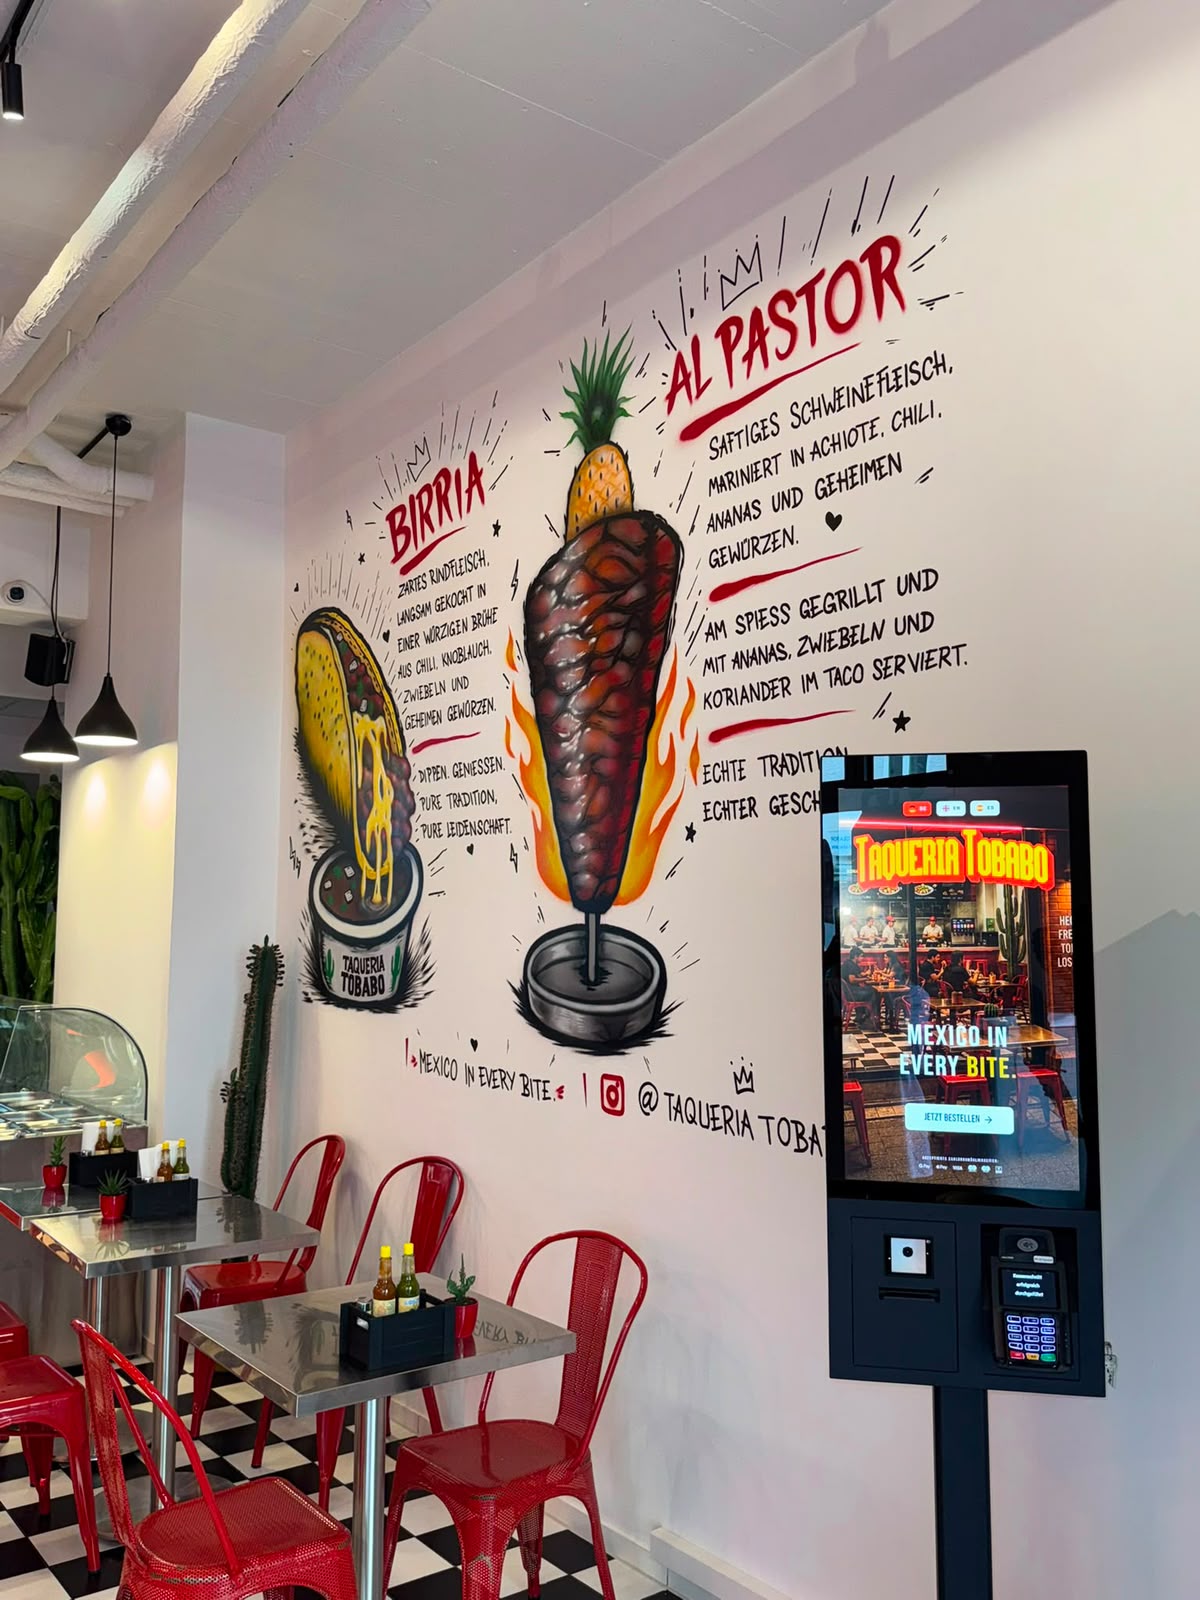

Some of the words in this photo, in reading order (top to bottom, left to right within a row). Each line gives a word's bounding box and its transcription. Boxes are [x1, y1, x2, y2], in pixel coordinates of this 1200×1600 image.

[665, 334, 712, 416] AL
[715, 234, 906, 389] PASTOR
[709, 412, 780, 460] SAFTIGES
[790, 350, 953, 429] SCHWEINEFLEISCH,
[708, 453, 782, 497] MARINIERT
[790, 447, 805, 468] IN
[706, 499, 762, 534] ANANAS
[771, 487, 803, 513] UND
[814, 451, 902, 501] GEHEIMEN
[385, 451, 485, 564] BIRRIA
[708, 525, 799, 569] GEWÜRZEN.
[397, 573, 428, 599] ZARTES
[397, 601, 432, 626] LANGSAM
[434, 585, 474, 612] GEKOCHT
[477, 582, 487, 599] IN
[704, 619, 727, 643] AM
[735, 603, 791, 635] SPIESS
[800, 579, 886, 620] GEGRILLT
[897, 568, 939, 596] UND
[397, 632, 420, 653] EINER
[423, 617, 468, 645] WÜRZIGEN
[471, 606, 499, 631] BRÜHE
[702, 654, 727, 677] MIT
[731, 642, 792, 670] ANANAS,
[797, 619, 886, 657] ZWIEBELN
[894, 611, 935, 636] UND
[397, 662, 412, 679] AUS
[702, 676, 791, 710] KORIANDER
[801, 673, 819, 694] IM
[823, 663, 864, 688] TACO
[872, 644, 968, 681] SERVIERT.
[403, 680, 446, 704] ZWIEBELN
[451, 675, 470, 692] UND
[404, 709, 442, 731] GEHEIMEN
[418, 765, 450, 783] DIPPEN.
[452, 756, 505, 779] GENIESSEN.
[703, 759, 746, 785] ECHTE
[419, 794, 442, 811] PURE
[446, 789, 498, 809] TRADITION,
[703, 796, 758, 822] ECHTER
[421, 822, 443, 839] PURE
[446, 818, 512, 838] LEIDENSCHAFT.
[342, 954, 385, 975] TAQUERIA
[341, 971, 385, 997] TOBABO
[907, 1023, 980, 1047] MEXICO
[987, 1026, 1008, 1048] IN
[418, 1049, 458, 1081] MEXICO
[464, 1063, 475, 1088] IN
[478, 1066, 516, 1091] EVERY
[519, 1073, 557, 1102] BITE.
[900, 1053, 959, 1077] EVERY
[967, 1056, 1017, 1079] BITE.
[924, 1112, 942, 1121] JETZT
[944, 1113, 980, 1123] BESTELLEN
